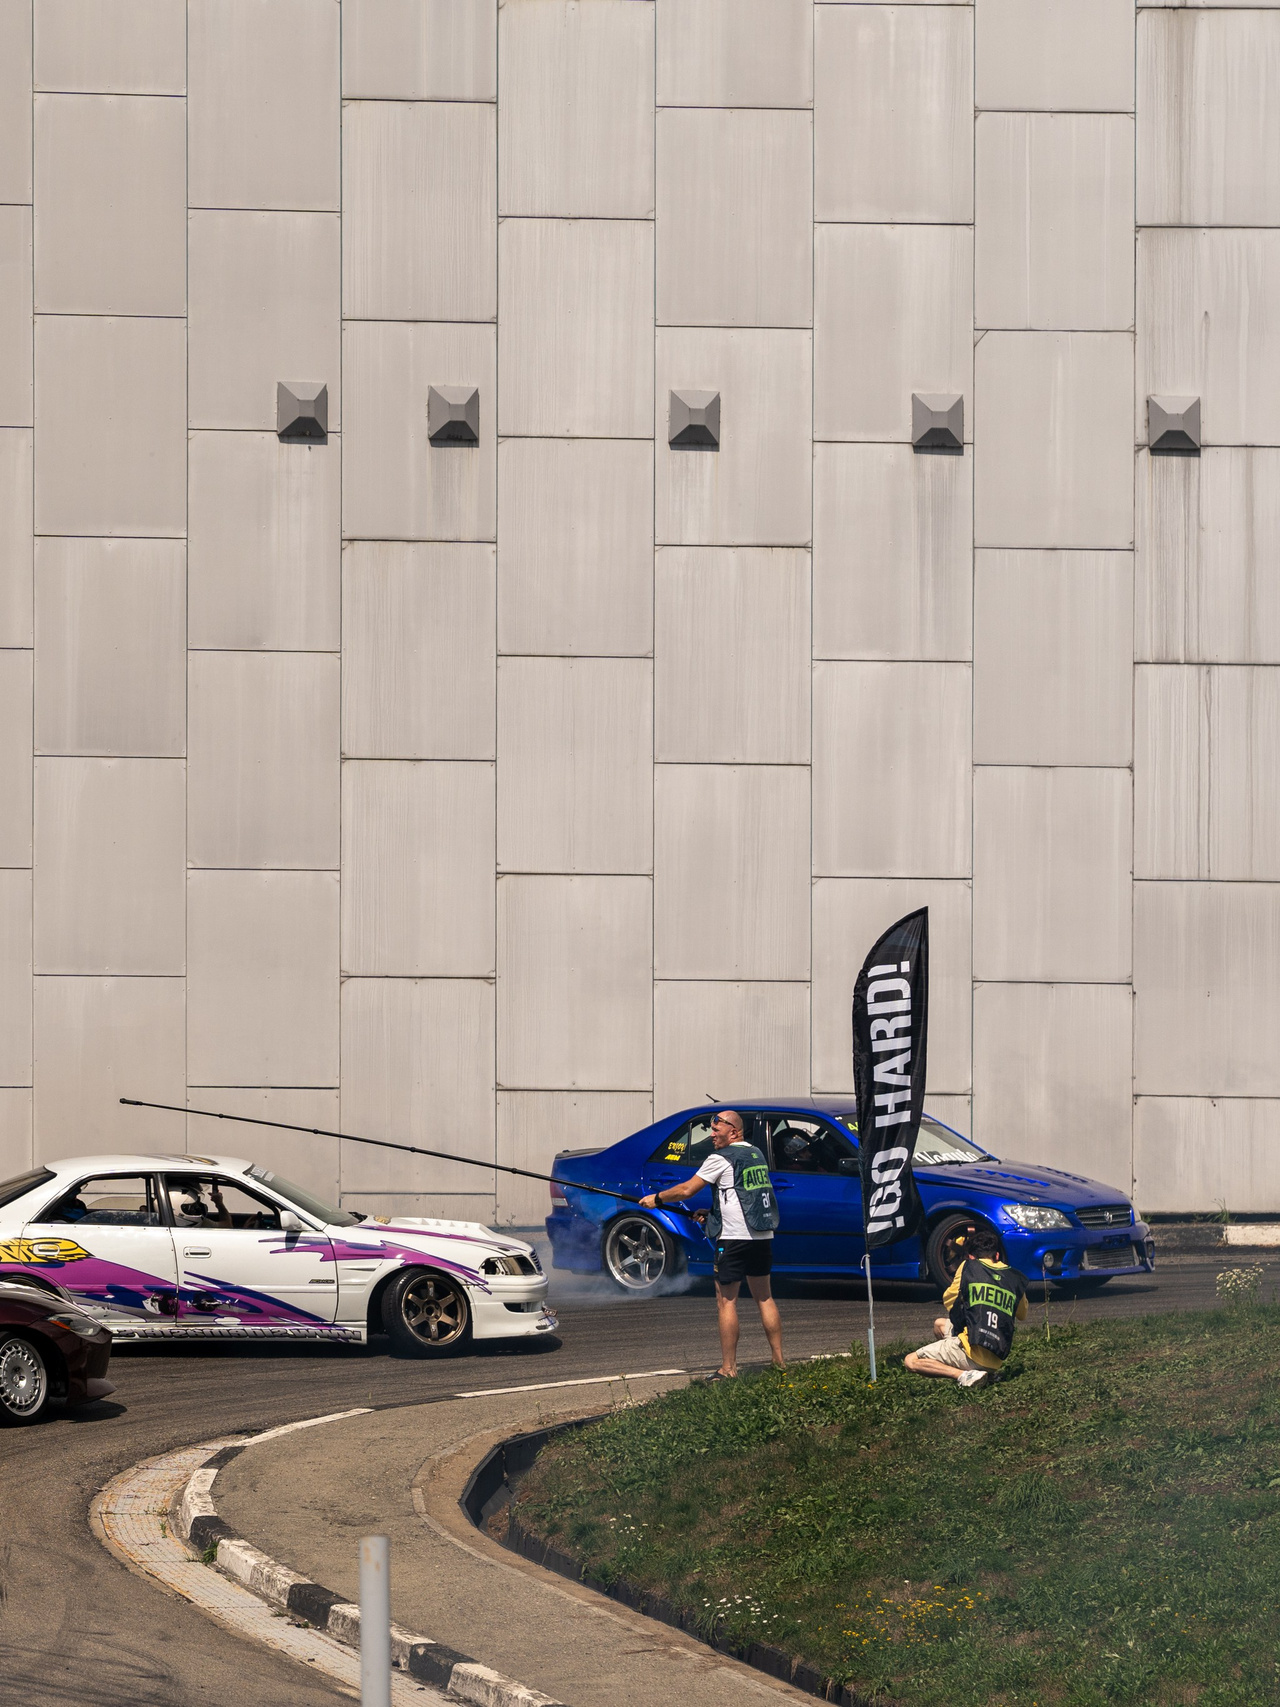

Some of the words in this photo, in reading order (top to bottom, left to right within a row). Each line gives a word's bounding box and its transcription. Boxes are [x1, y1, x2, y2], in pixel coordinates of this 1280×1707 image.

[866, 961, 912, 1128] HARD!
[972, 1285, 1014, 1312] MEDIA
[986, 1311, 998, 1329] 19
